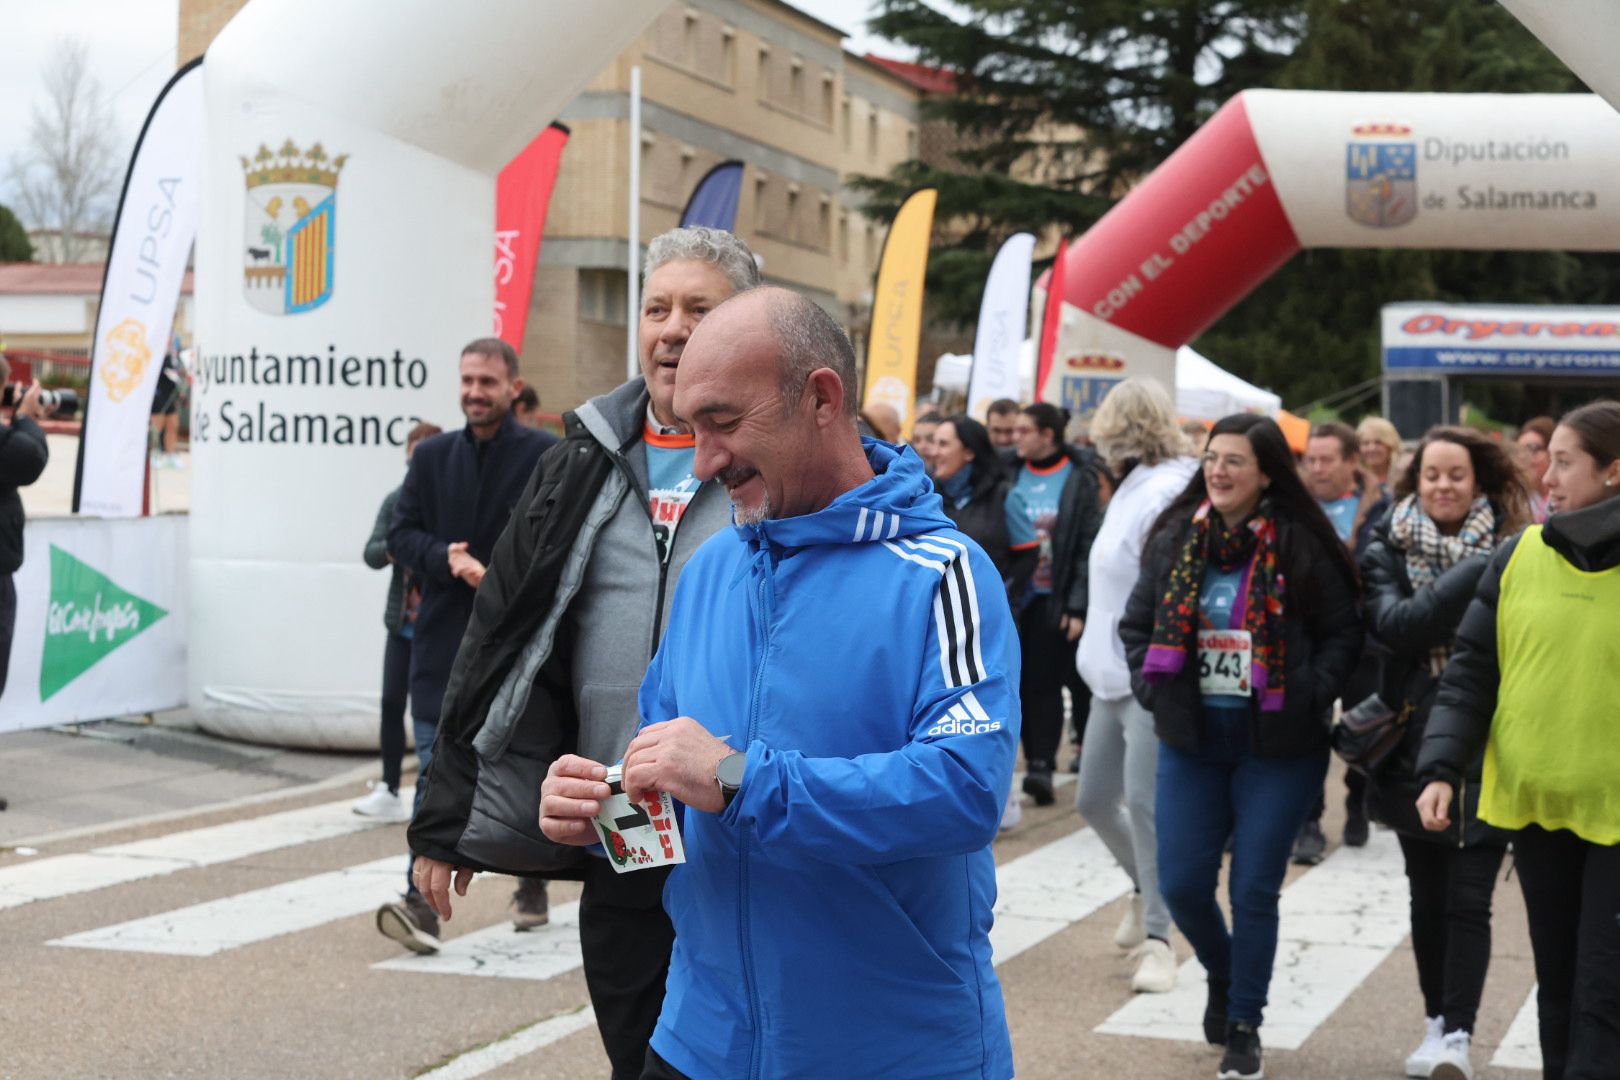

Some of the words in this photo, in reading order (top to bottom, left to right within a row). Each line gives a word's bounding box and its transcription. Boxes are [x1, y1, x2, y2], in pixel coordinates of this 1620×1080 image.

[1424, 136, 1569, 165] Diputación
[1422, 191, 1446, 210] de
[1457, 185, 1597, 210] Salamanca
[130, 177, 182, 305] UPSA
[1094, 274, 1143, 320] CON
[1140, 253, 1174, 281] EL
[1169, 163, 1268, 255] DEPORTE
[927, 719, 1001, 736] adidas
